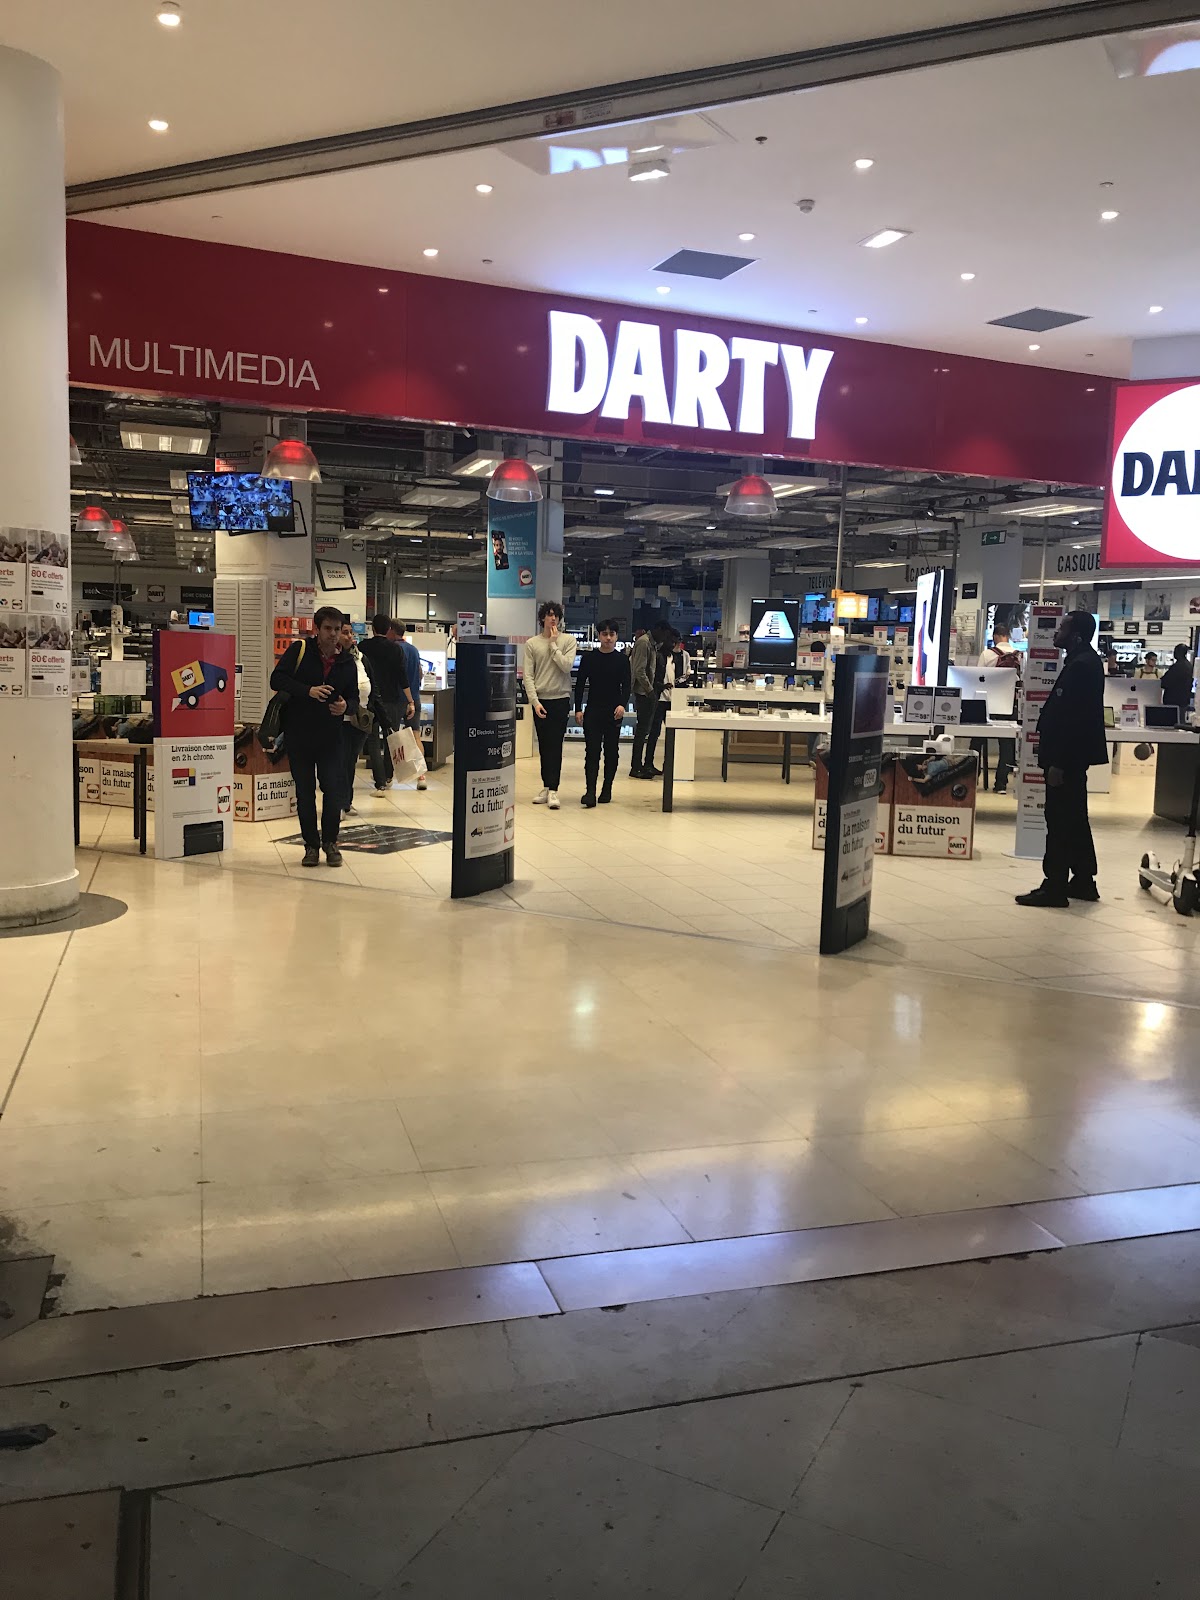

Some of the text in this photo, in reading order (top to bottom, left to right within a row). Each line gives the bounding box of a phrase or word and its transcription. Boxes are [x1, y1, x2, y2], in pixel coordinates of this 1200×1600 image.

[89, 334, 320, 391] MULTIMEDIA
[545, 310, 834, 440] DARTY
[1121, 450, 1200, 497] DA
[147, 590, 165, 598] DARTY
[181, 673, 195, 682] DARTY
[171, 744, 227, 753] Livraison chez vous
[192, 753, 215, 761] chrono.
[102, 766, 111, 776] La
[102, 777, 131, 788] du futur
[257, 778, 296, 791] La maison
[257, 789, 288, 801] du futur
[471, 784, 509, 799] La maison
[217, 795, 231, 804] DARTY
[471, 799, 505, 814] du futur
[898, 811, 961, 825] La maison
[843, 818, 871, 838] La maison
[897, 823, 947, 836] du futur
[842, 836, 864, 855] du futur
[949, 842, 966, 850] DARTY
